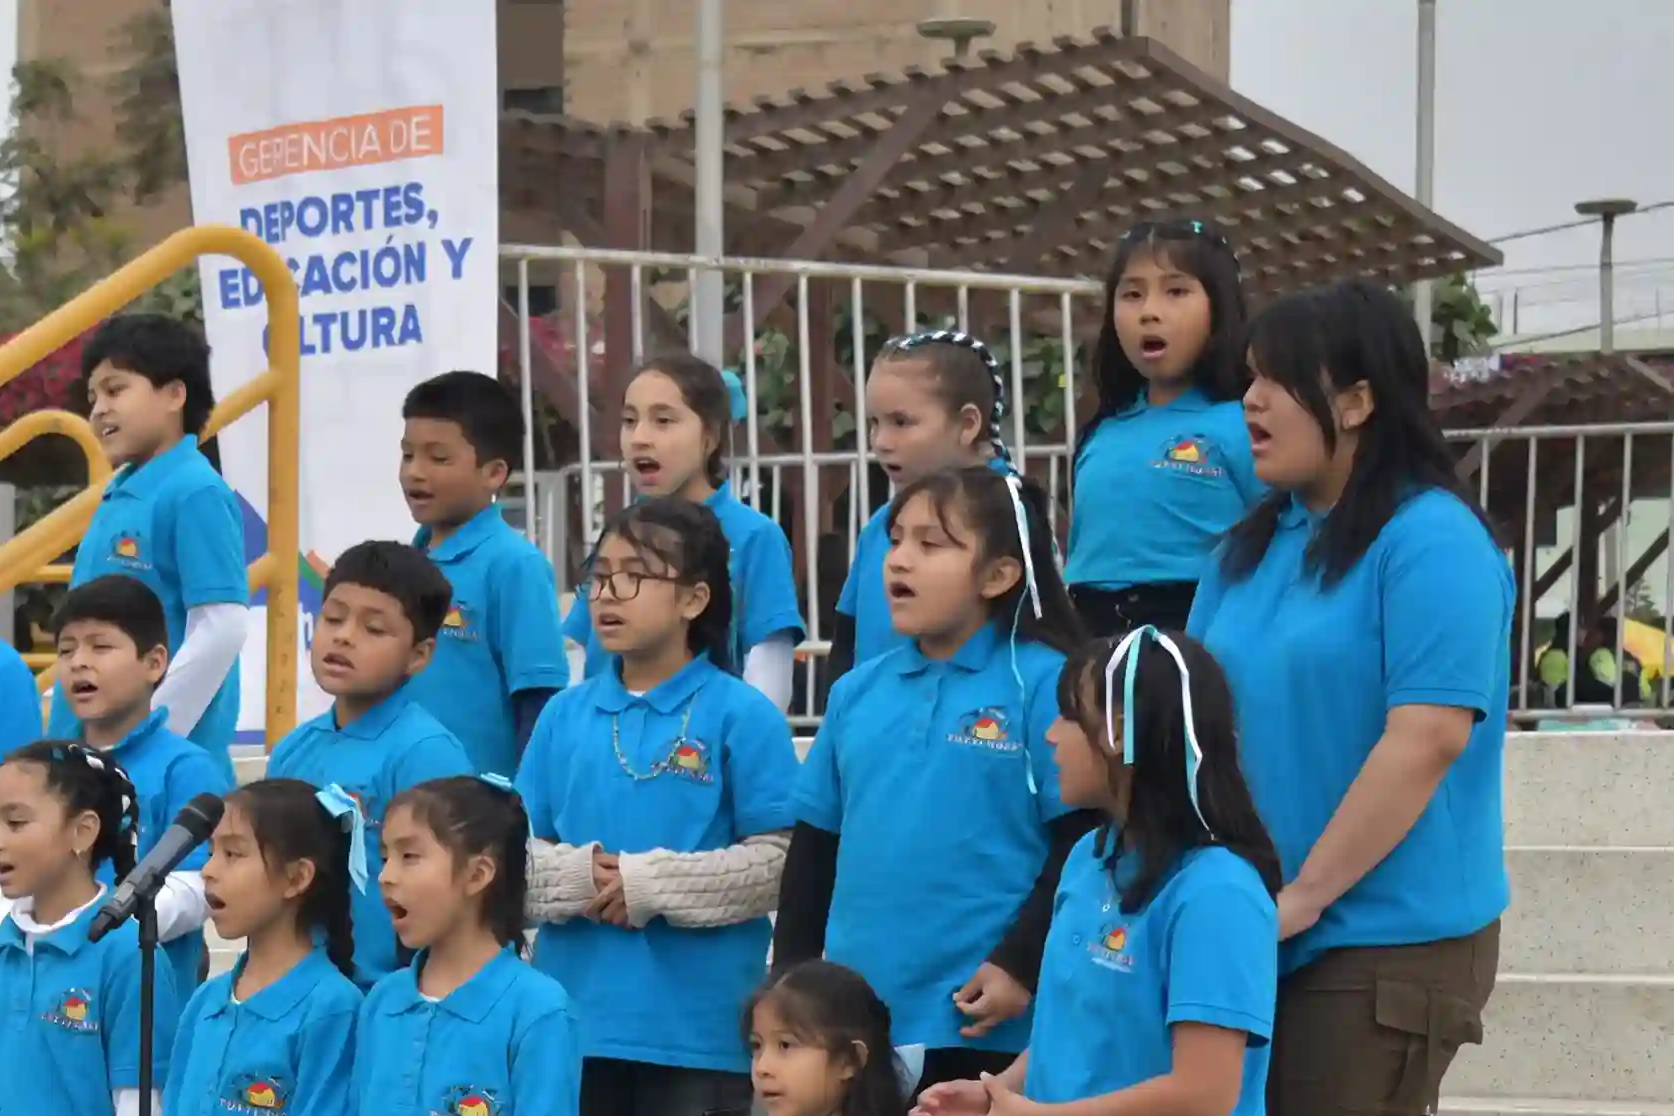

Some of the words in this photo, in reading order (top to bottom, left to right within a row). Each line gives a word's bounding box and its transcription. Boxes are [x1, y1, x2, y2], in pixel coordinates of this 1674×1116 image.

[389, 114, 432, 154] DE
[240, 182, 438, 244] DEPORTES,
[219, 235, 426, 309] EDACIÓN
[440, 237, 474, 280] Y
[263, 304, 423, 357] LTURA
